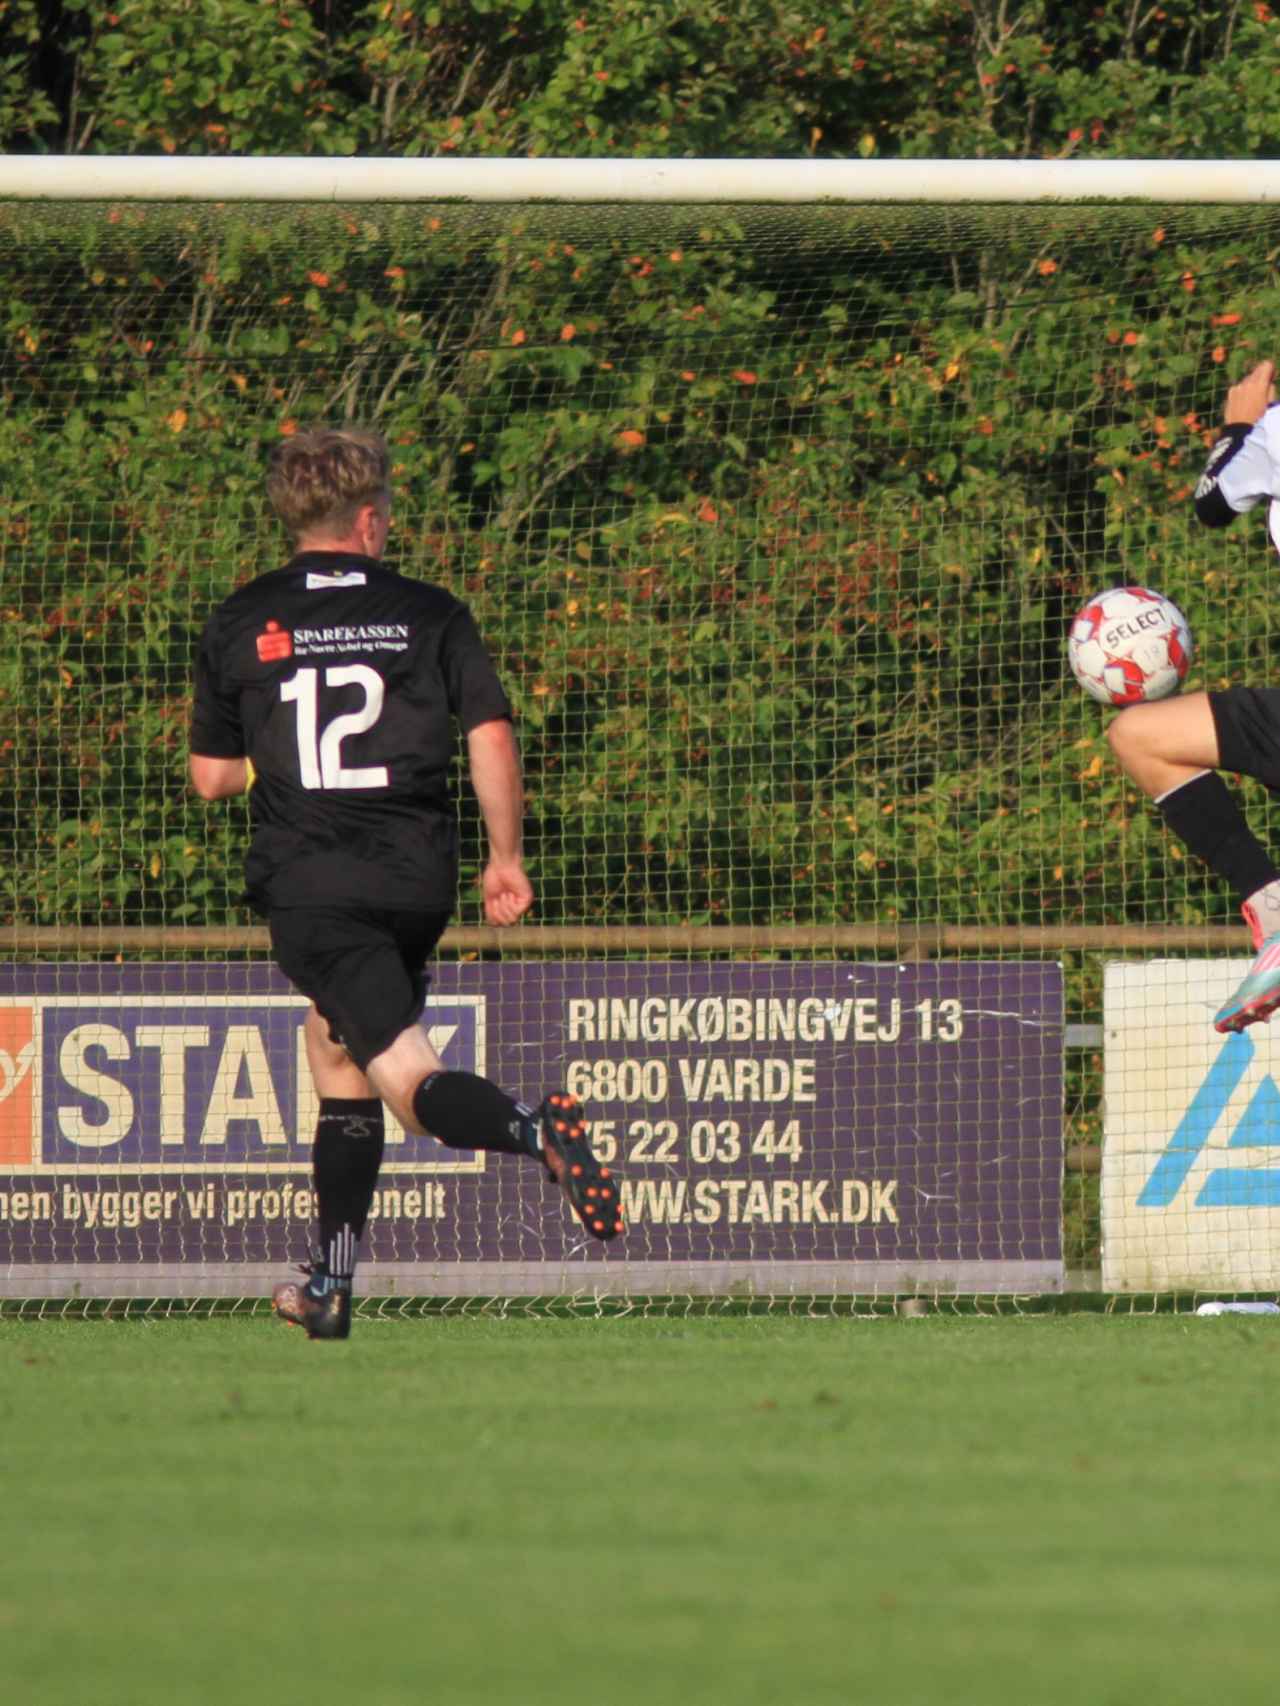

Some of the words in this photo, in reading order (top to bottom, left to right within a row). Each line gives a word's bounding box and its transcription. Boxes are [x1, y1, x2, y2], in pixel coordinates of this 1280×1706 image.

[294, 624, 408, 644] SPAREKASSEN
[1106, 608, 1166, 649] SELECT
[280, 664, 389, 790] 12
[568, 997, 900, 1043] RINGKØBINGVEJ
[916, 998, 963, 1042] 13
[58, 1024, 458, 1147] STA
[566, 1059, 668, 1102] 6800
[680, 1059, 816, 1102] VARDE
[585, 1120, 617, 1162] 5
[628, 1120, 679, 1162] 22
[691, 1119, 741, 1163] 03
[752, 1120, 802, 1162] 44
[63, 1184, 177, 1228] bygger
[187, 1183, 215, 1219] vi
[570, 1180, 898, 1224] WW.STARK.DK
